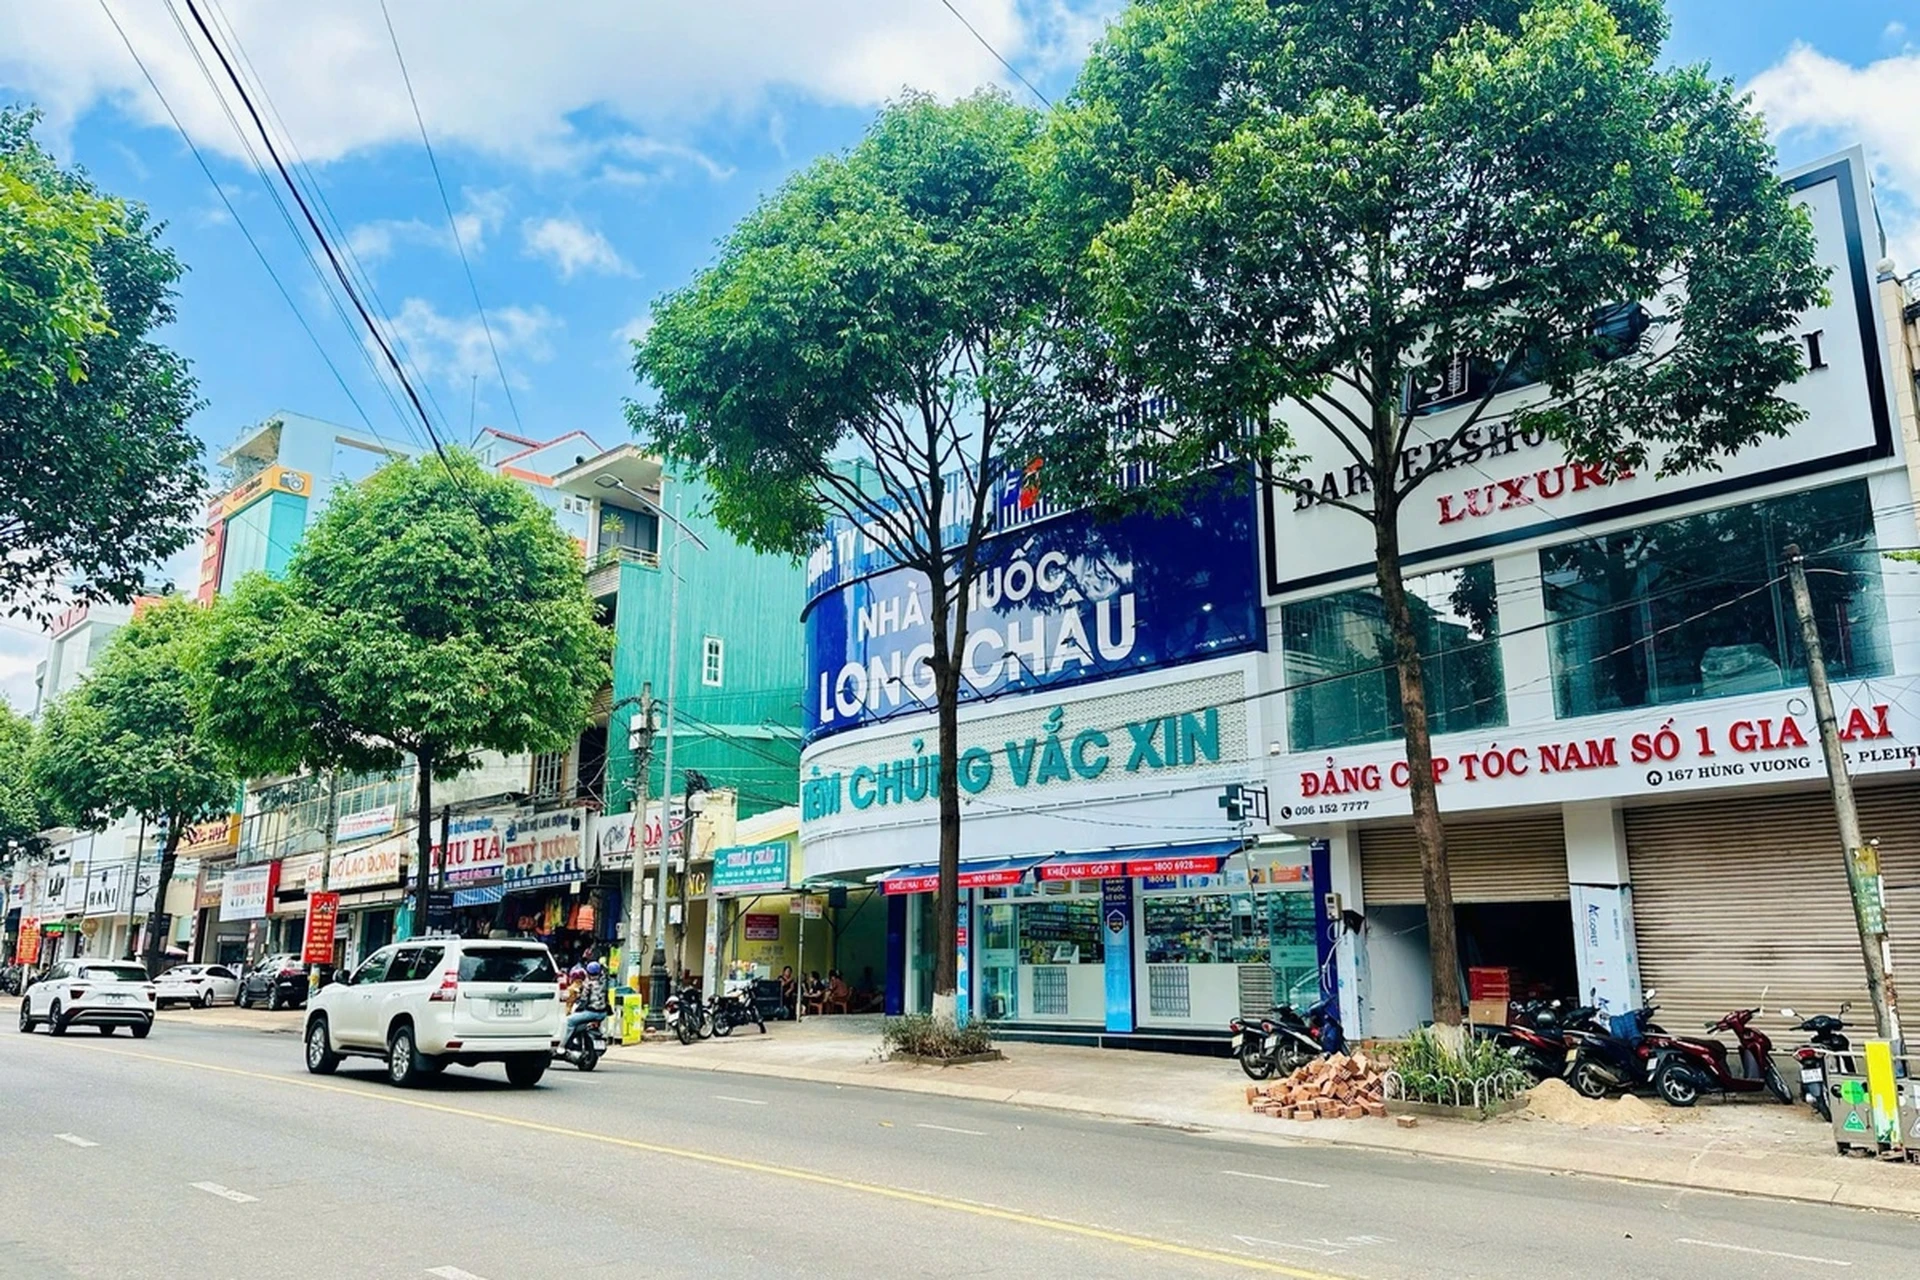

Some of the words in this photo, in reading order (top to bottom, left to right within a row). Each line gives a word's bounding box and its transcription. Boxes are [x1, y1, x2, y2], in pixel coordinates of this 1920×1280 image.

[1293, 415, 1560, 512] BARERSHO
[858, 582, 925, 642] NHÀ
[962, 588, 1137, 682] CHÂU
[1006, 706, 1110, 787] VẮC
[1125, 707, 1220, 772] XIN
[1390, 758, 1449, 787] CP
[1459, 743, 1530, 781] TÓC
[1538, 737, 1620, 774] NAM
[1631, 717, 1681, 764] SỐ
[1696, 726, 1716, 757] 1
[1728, 715, 1808, 754] GIA
[1824, 704, 1894, 742] AI
[1667, 768, 1694, 783] 167
[1319, 803, 1339, 814] 152
[1341, 800, 1370, 812] 7777
[472, 827, 501, 862] HÀ
[1154, 861, 1172, 871] 1800
[1174, 859, 1194, 870] 6928
